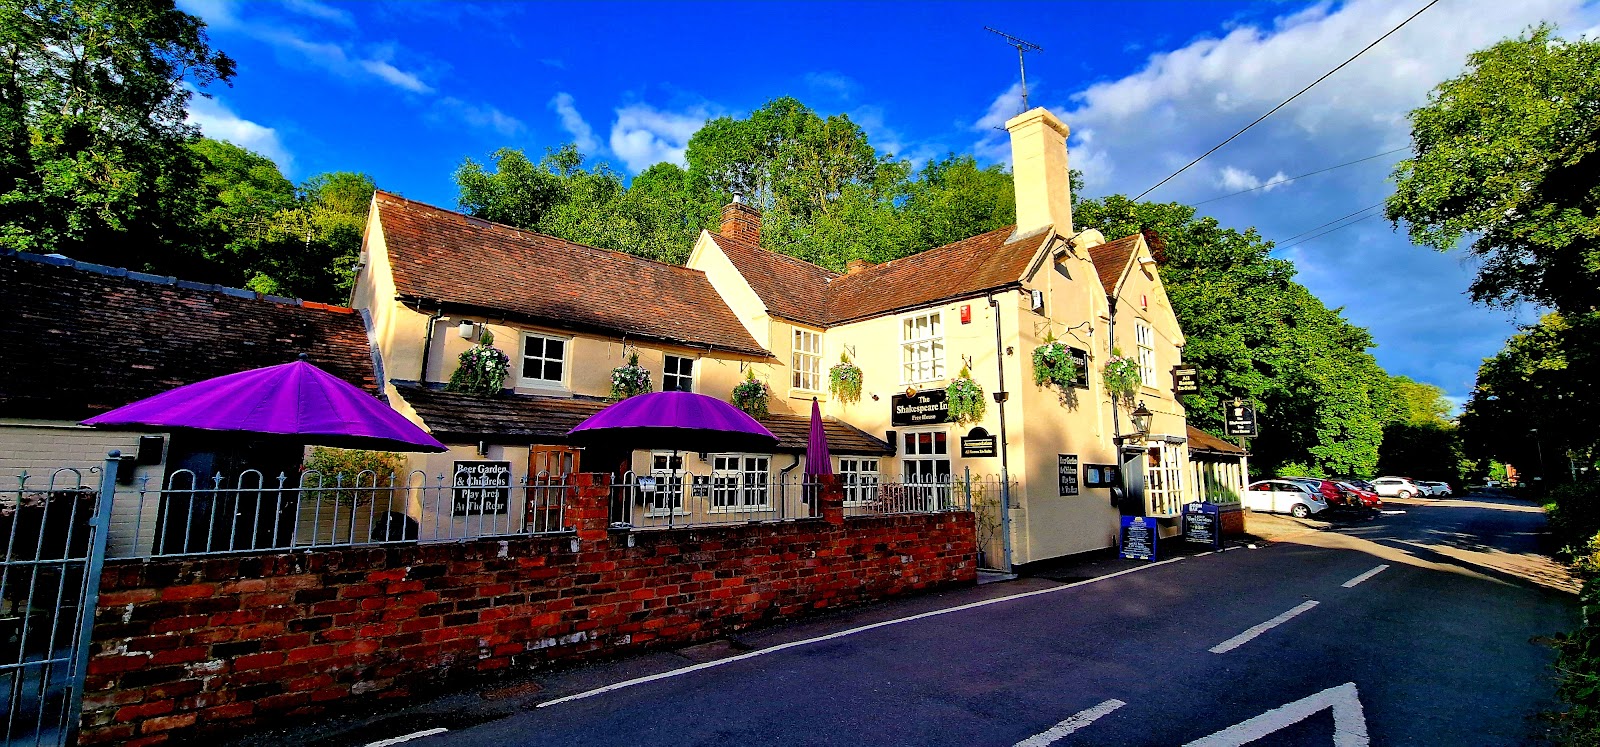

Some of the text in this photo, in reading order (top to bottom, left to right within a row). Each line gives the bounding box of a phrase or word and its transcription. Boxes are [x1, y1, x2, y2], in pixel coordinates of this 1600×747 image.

[896, 401, 949, 414] Shakespeare In
[457, 464, 507, 474] Beer Garden
[457, 476, 506, 486] & Chidrens
[462, 489, 479, 500] Pay
